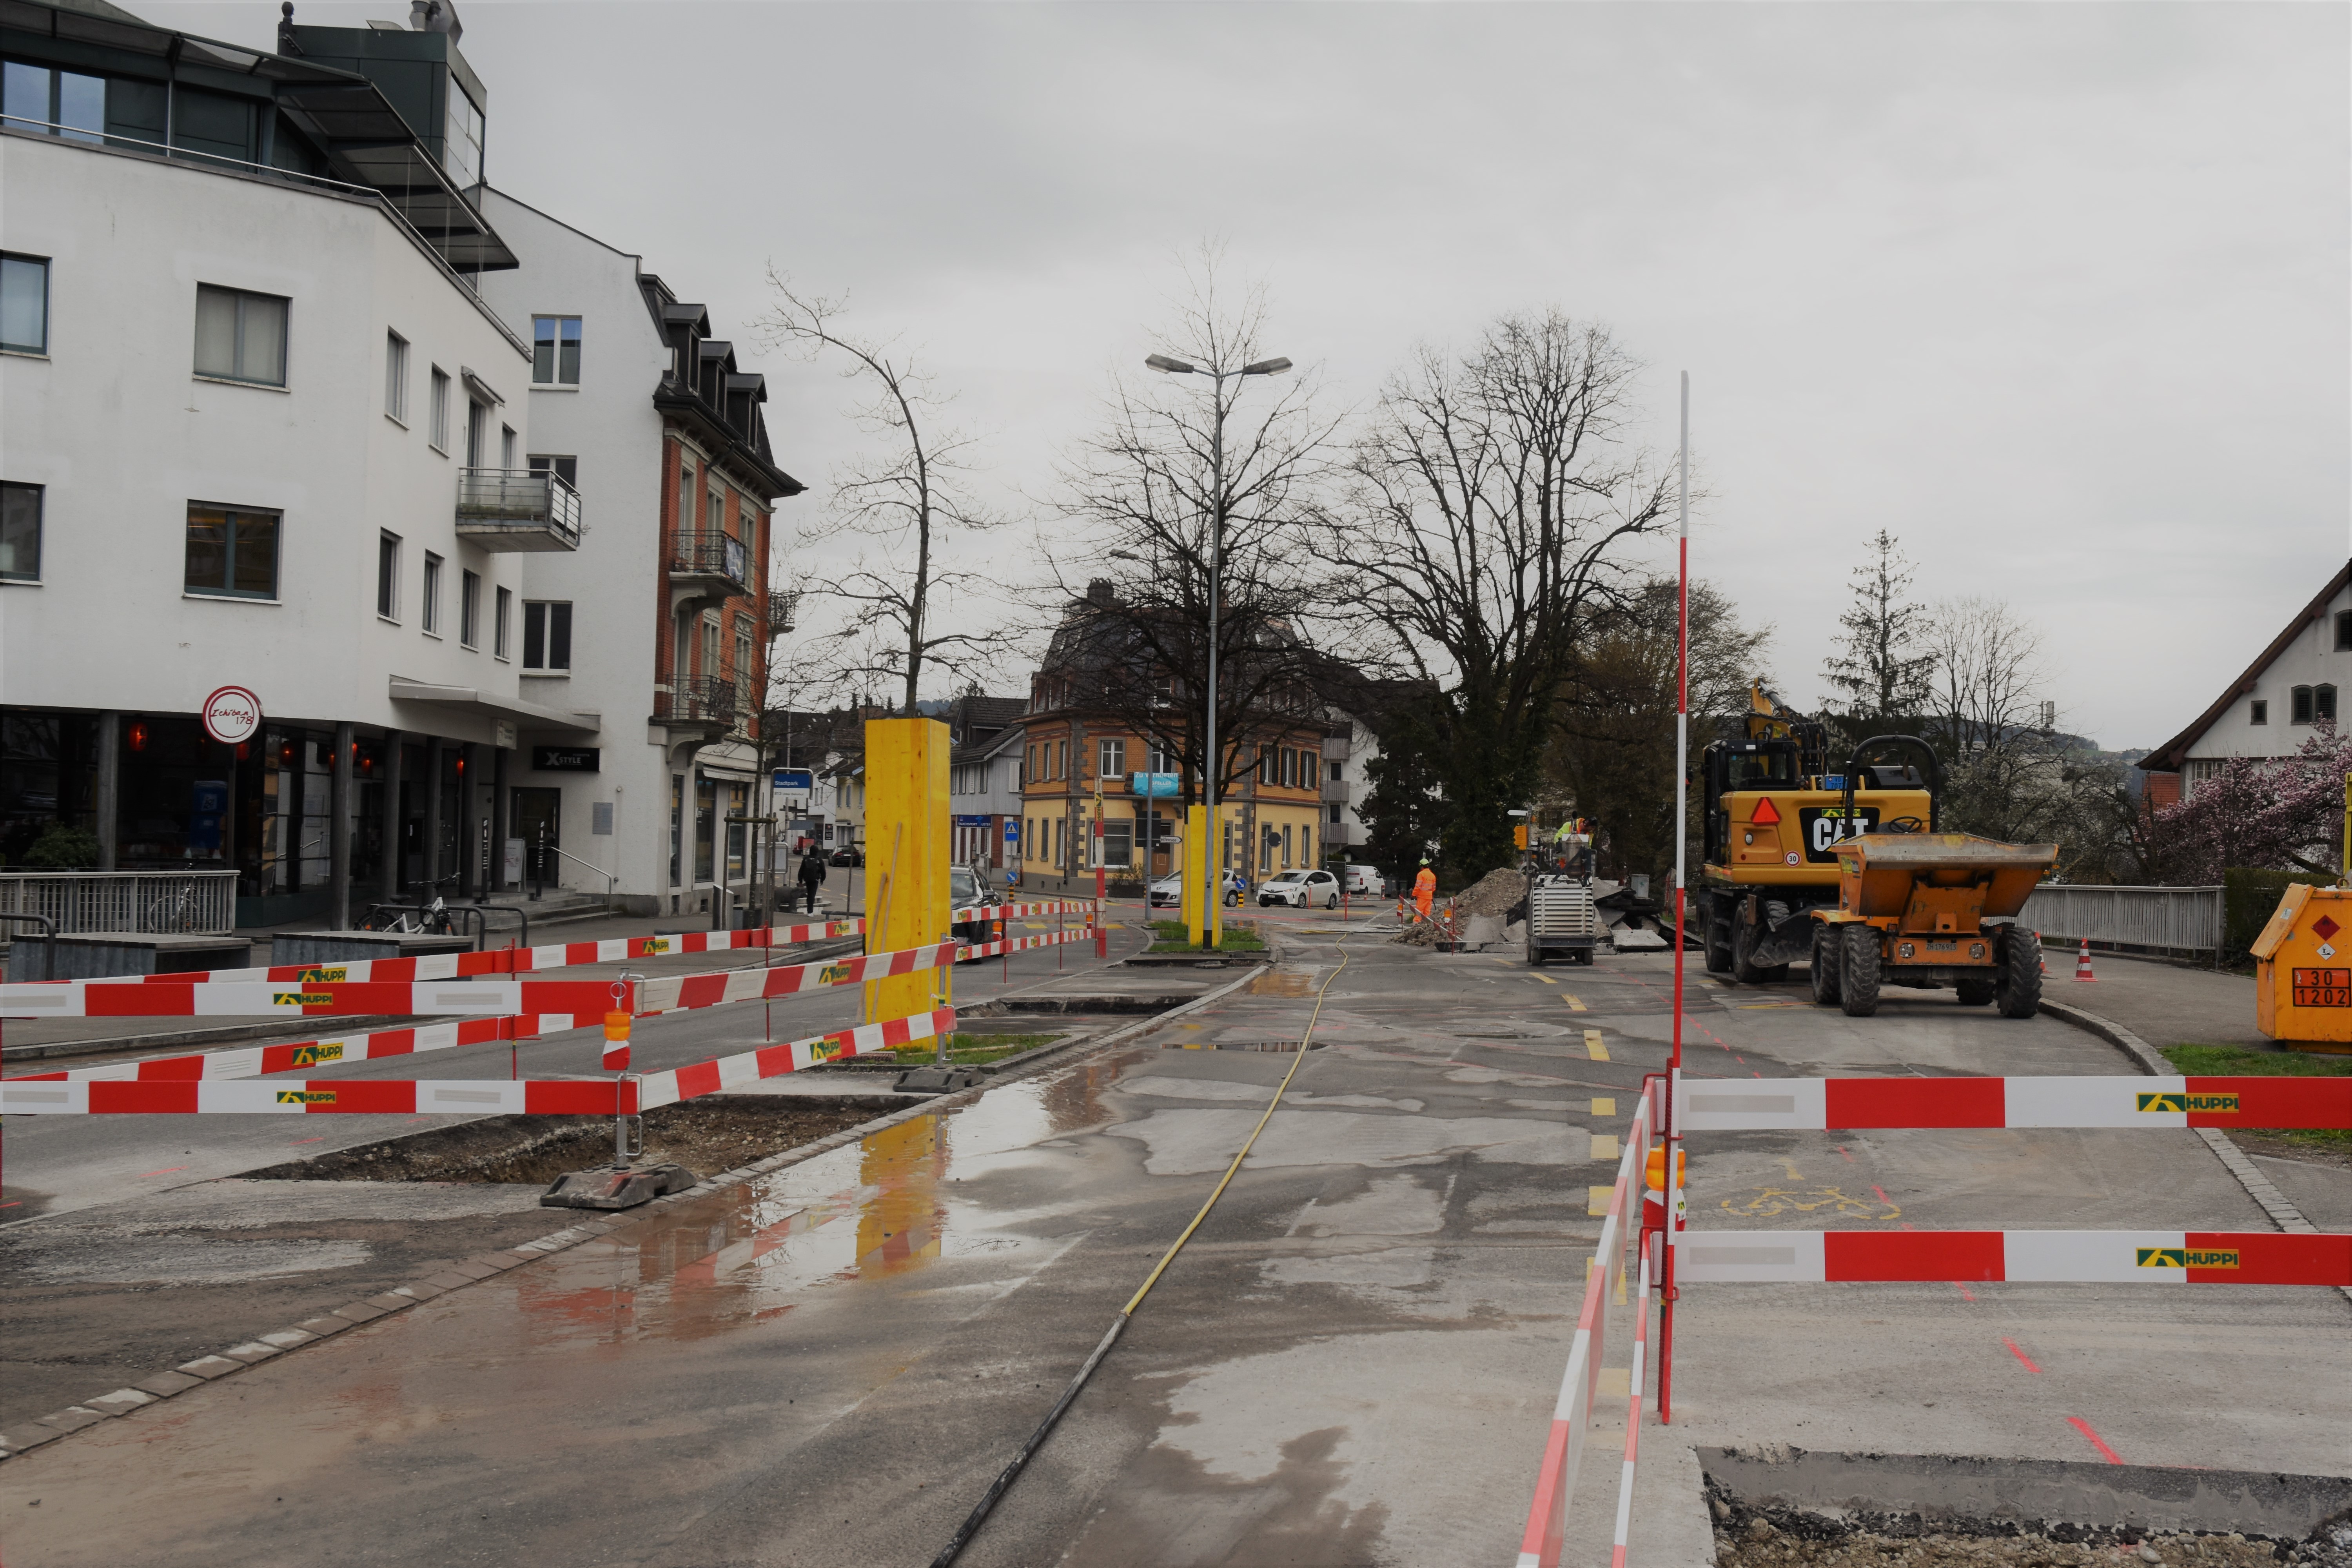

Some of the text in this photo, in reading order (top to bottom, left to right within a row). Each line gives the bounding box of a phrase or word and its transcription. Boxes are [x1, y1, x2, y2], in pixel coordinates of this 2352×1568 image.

[236, 716, 254, 724] 178
[1813, 818, 1868, 851] CAT
[2311, 971, 2332, 985] 30
[2299, 989, 2346, 1004] 1202
